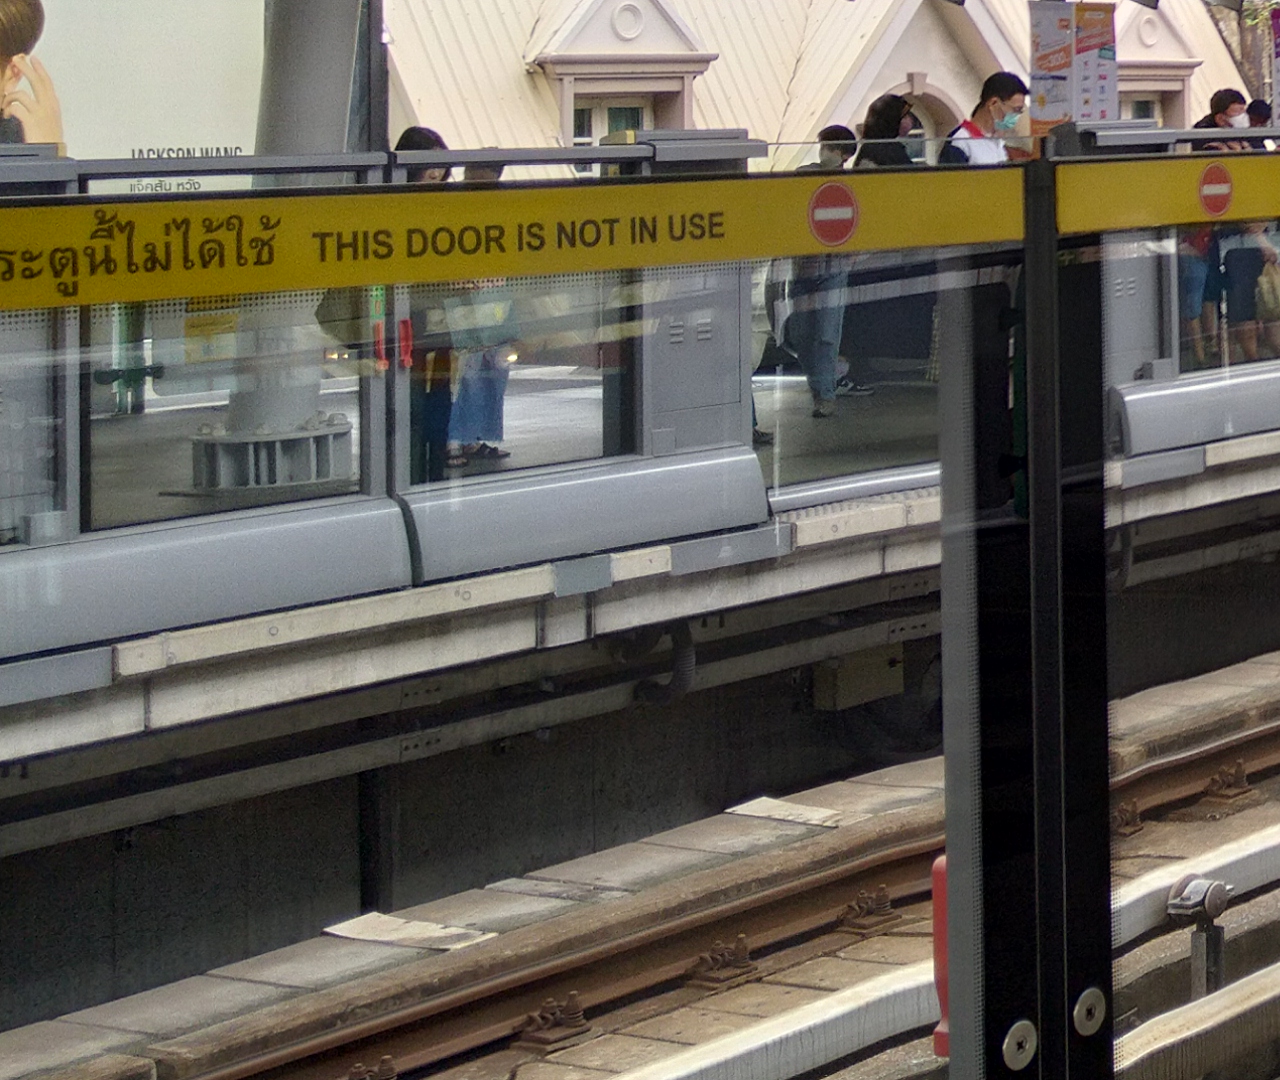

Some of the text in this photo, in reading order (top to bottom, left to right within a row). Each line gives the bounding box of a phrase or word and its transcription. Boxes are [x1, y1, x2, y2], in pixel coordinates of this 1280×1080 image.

[312, 229, 394, 262] THIS
[406, 225, 506, 258] DOOR
[517, 222, 546, 252] IS
[556, 219, 620, 250] NOT
[630, 216, 657, 246] IN
[669, 211, 726, 241] USE
